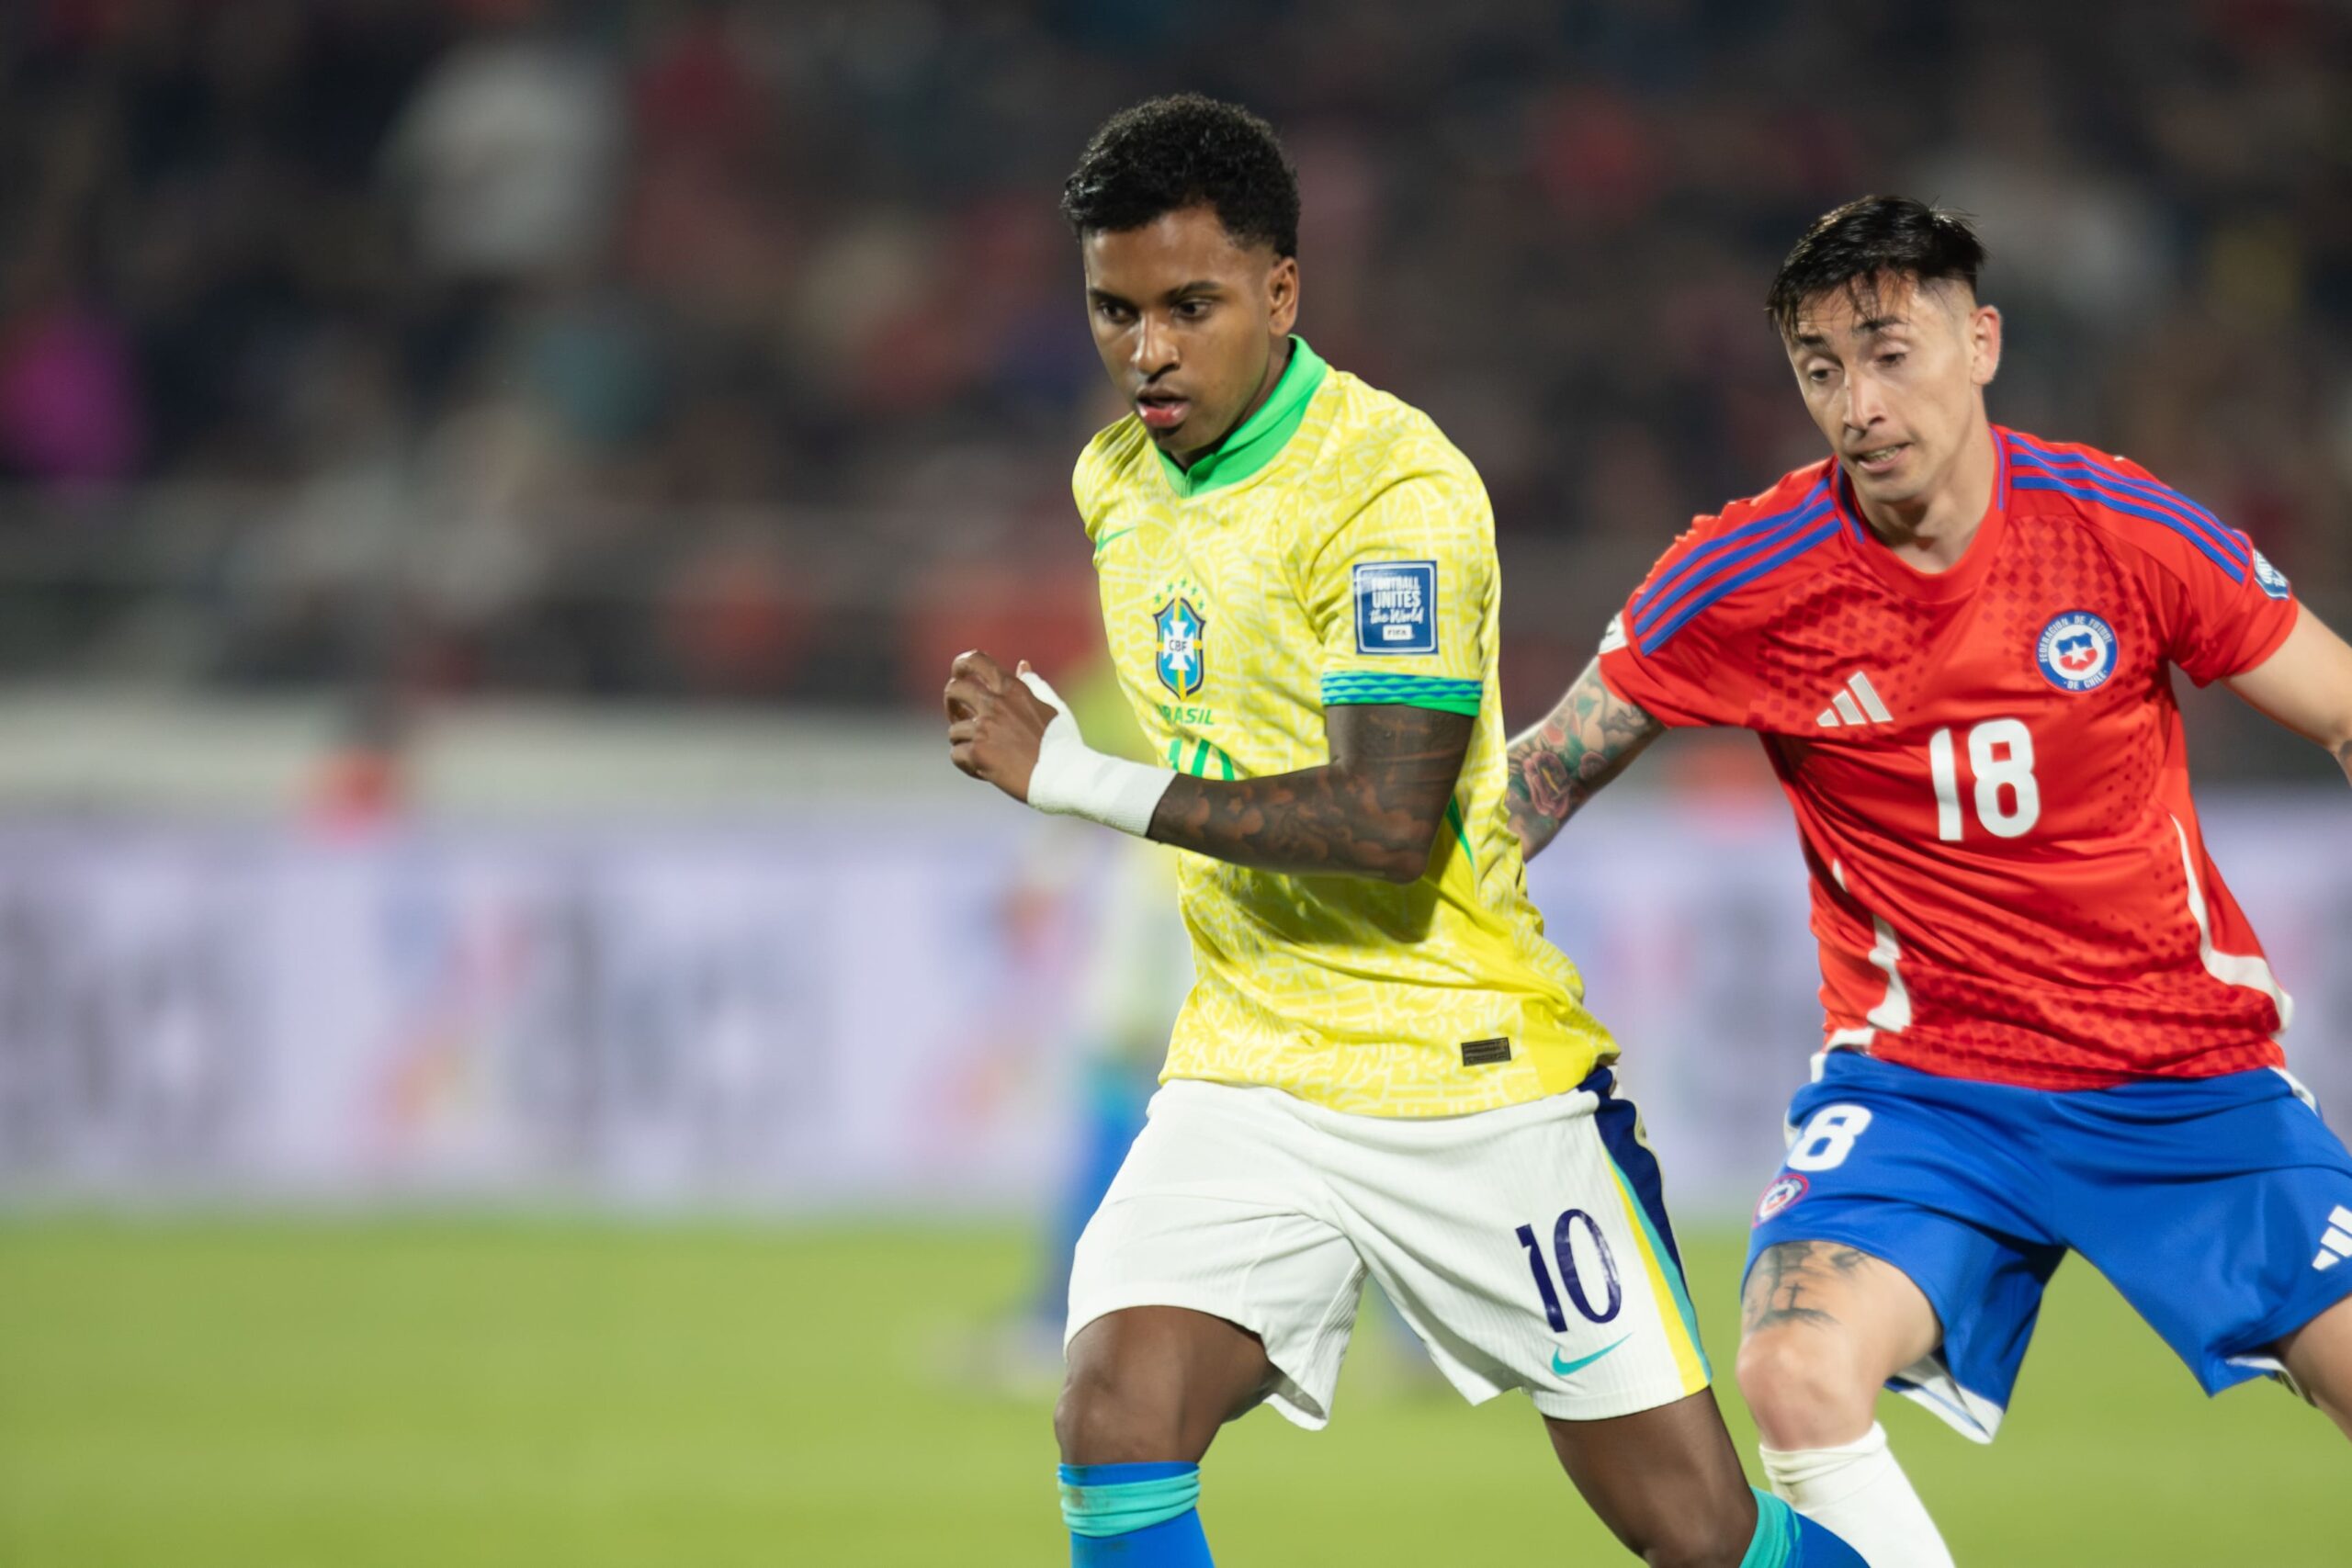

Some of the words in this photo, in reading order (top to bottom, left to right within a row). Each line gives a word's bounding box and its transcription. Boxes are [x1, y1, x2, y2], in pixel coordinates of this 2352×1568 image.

[1372, 591, 1421, 608] UNITES
[1369, 607, 1389, 624] the
[1389, 605, 1425, 624] World
[2074, 615, 2086, 626] DE
[1169, 639, 1188, 651] CBF
[2067, 681, 2080, 690] DE
[1158, 705, 1215, 726] RASIL
[1930, 717, 2041, 842] 18
[1515, 1209, 1623, 1333] 10
